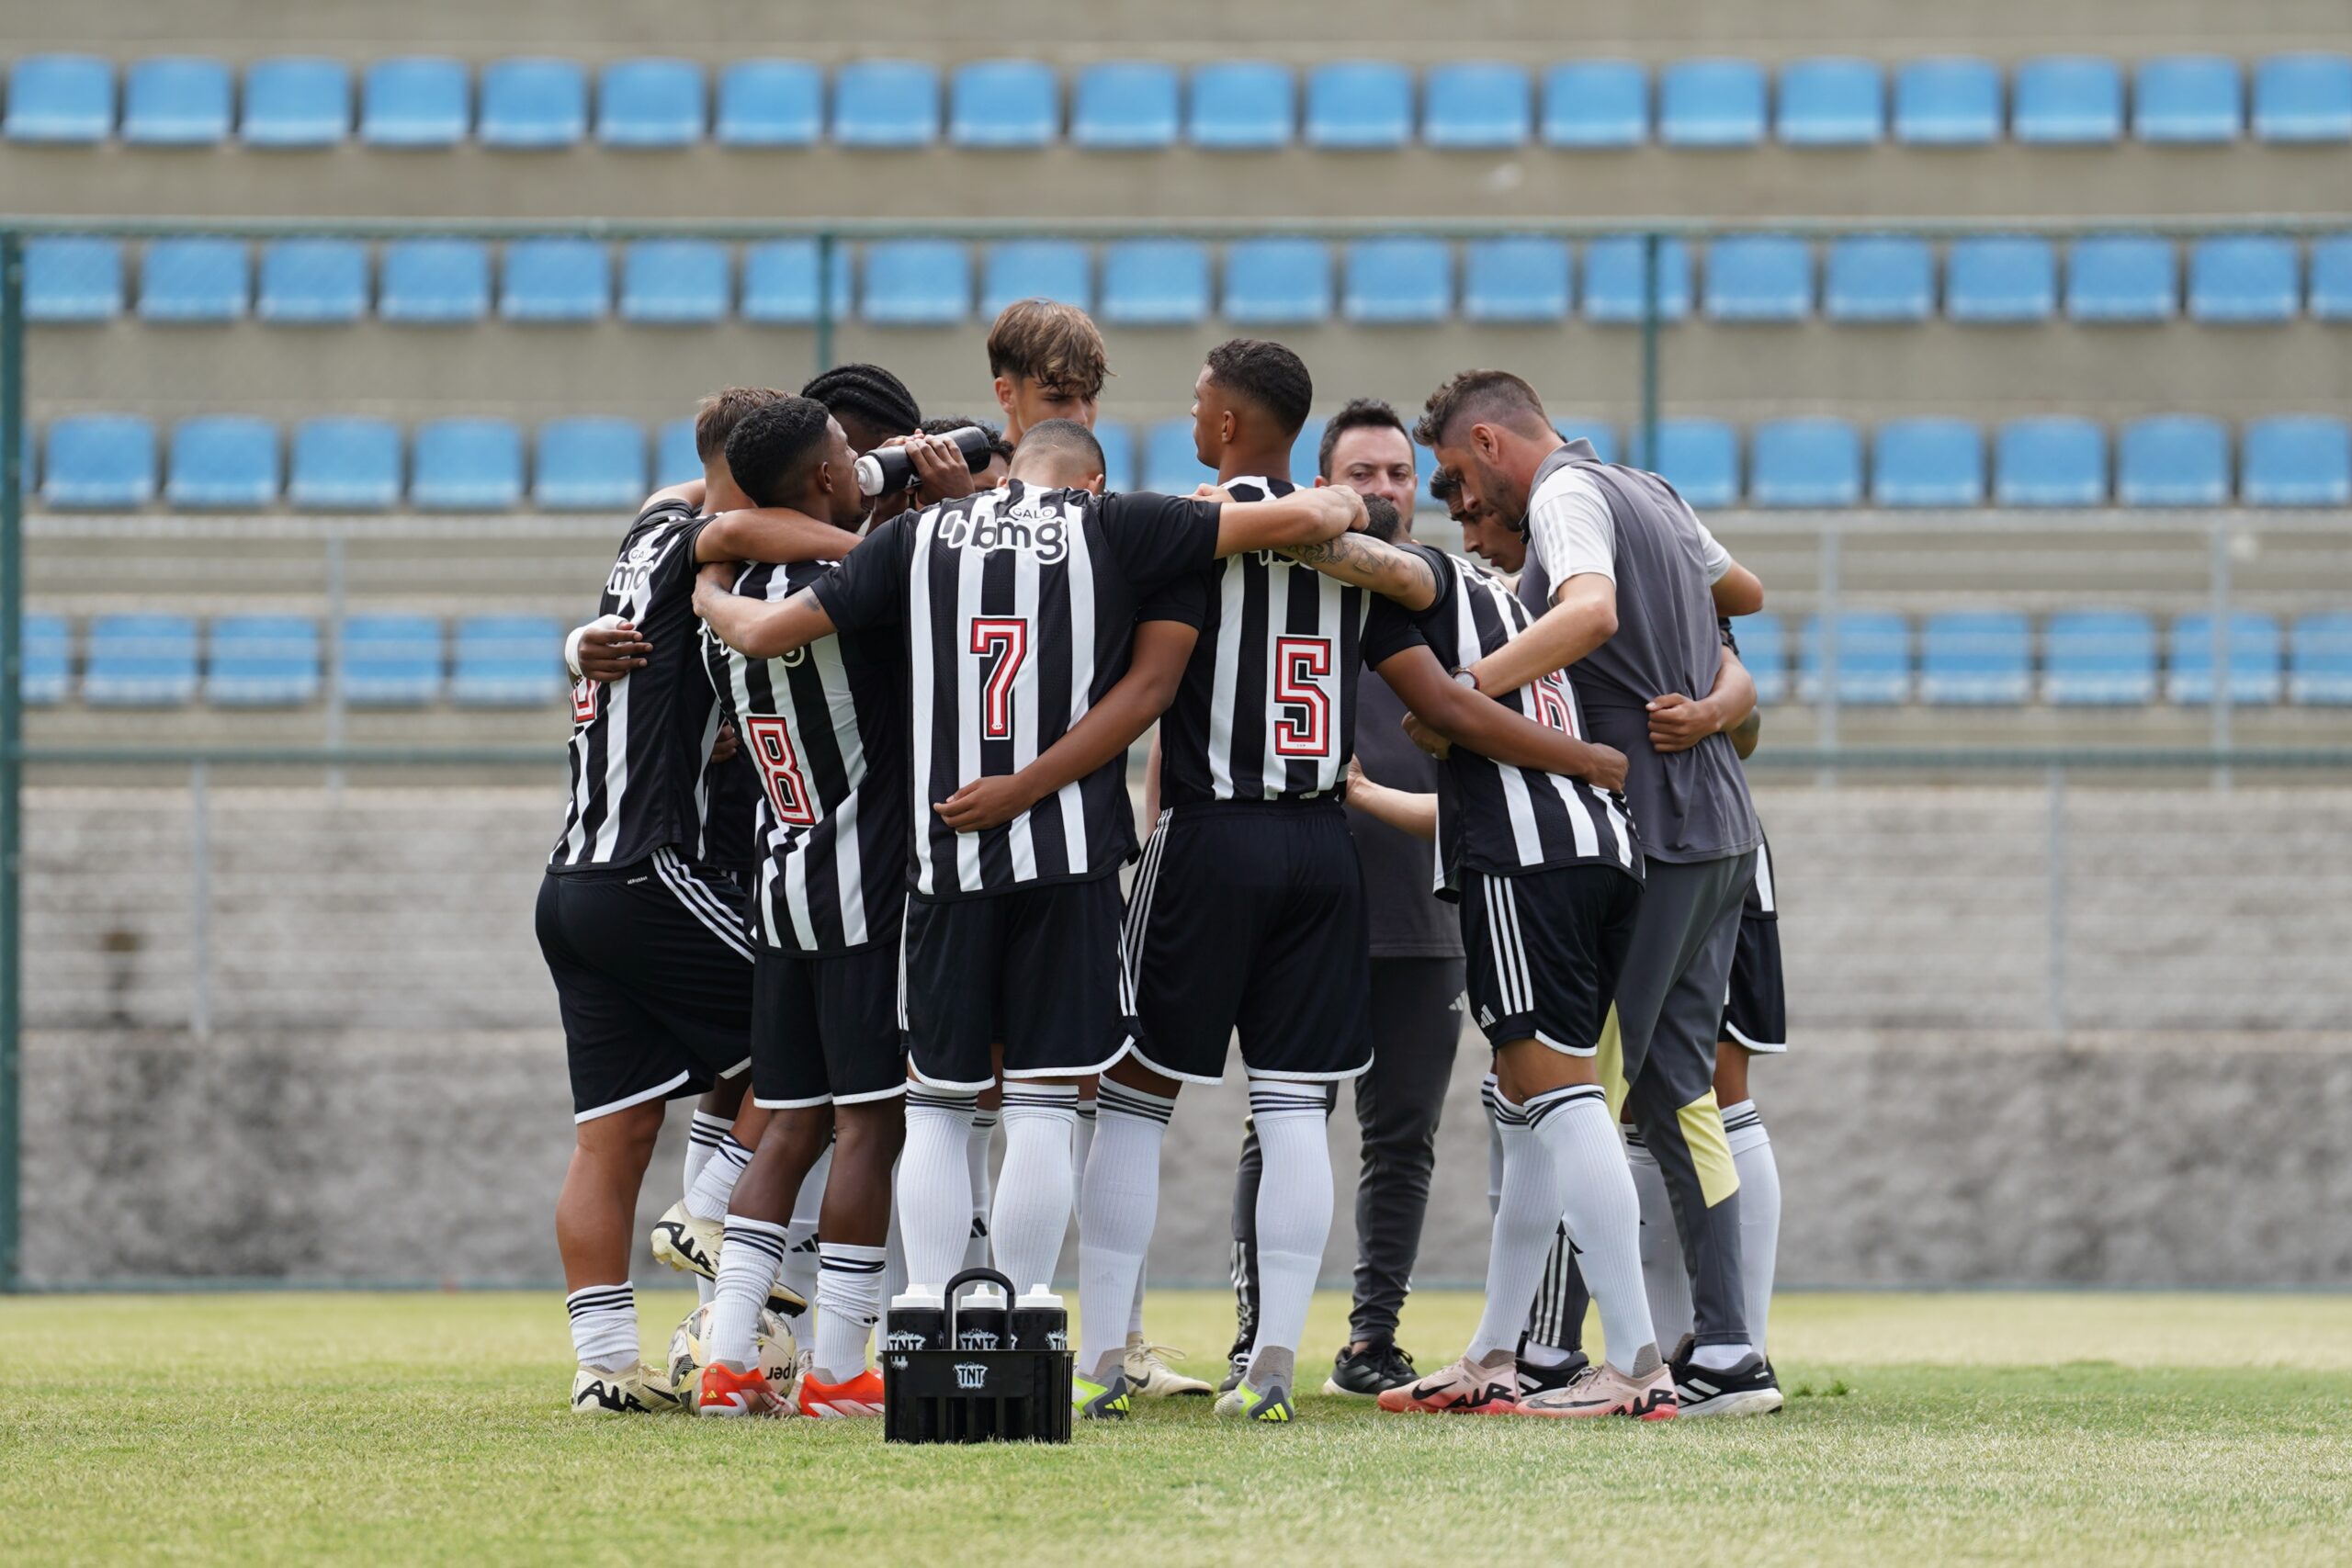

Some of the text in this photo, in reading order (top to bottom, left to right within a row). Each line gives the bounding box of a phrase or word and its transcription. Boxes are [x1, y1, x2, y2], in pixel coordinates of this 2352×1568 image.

[970, 514, 1066, 563] bmg
[1012, 507, 1054, 520] GALO
[969, 615, 1028, 740] 7
[1273, 634, 1332, 758] 5
[744, 714, 817, 828] 8
[959, 1368, 983, 1385] TNT
